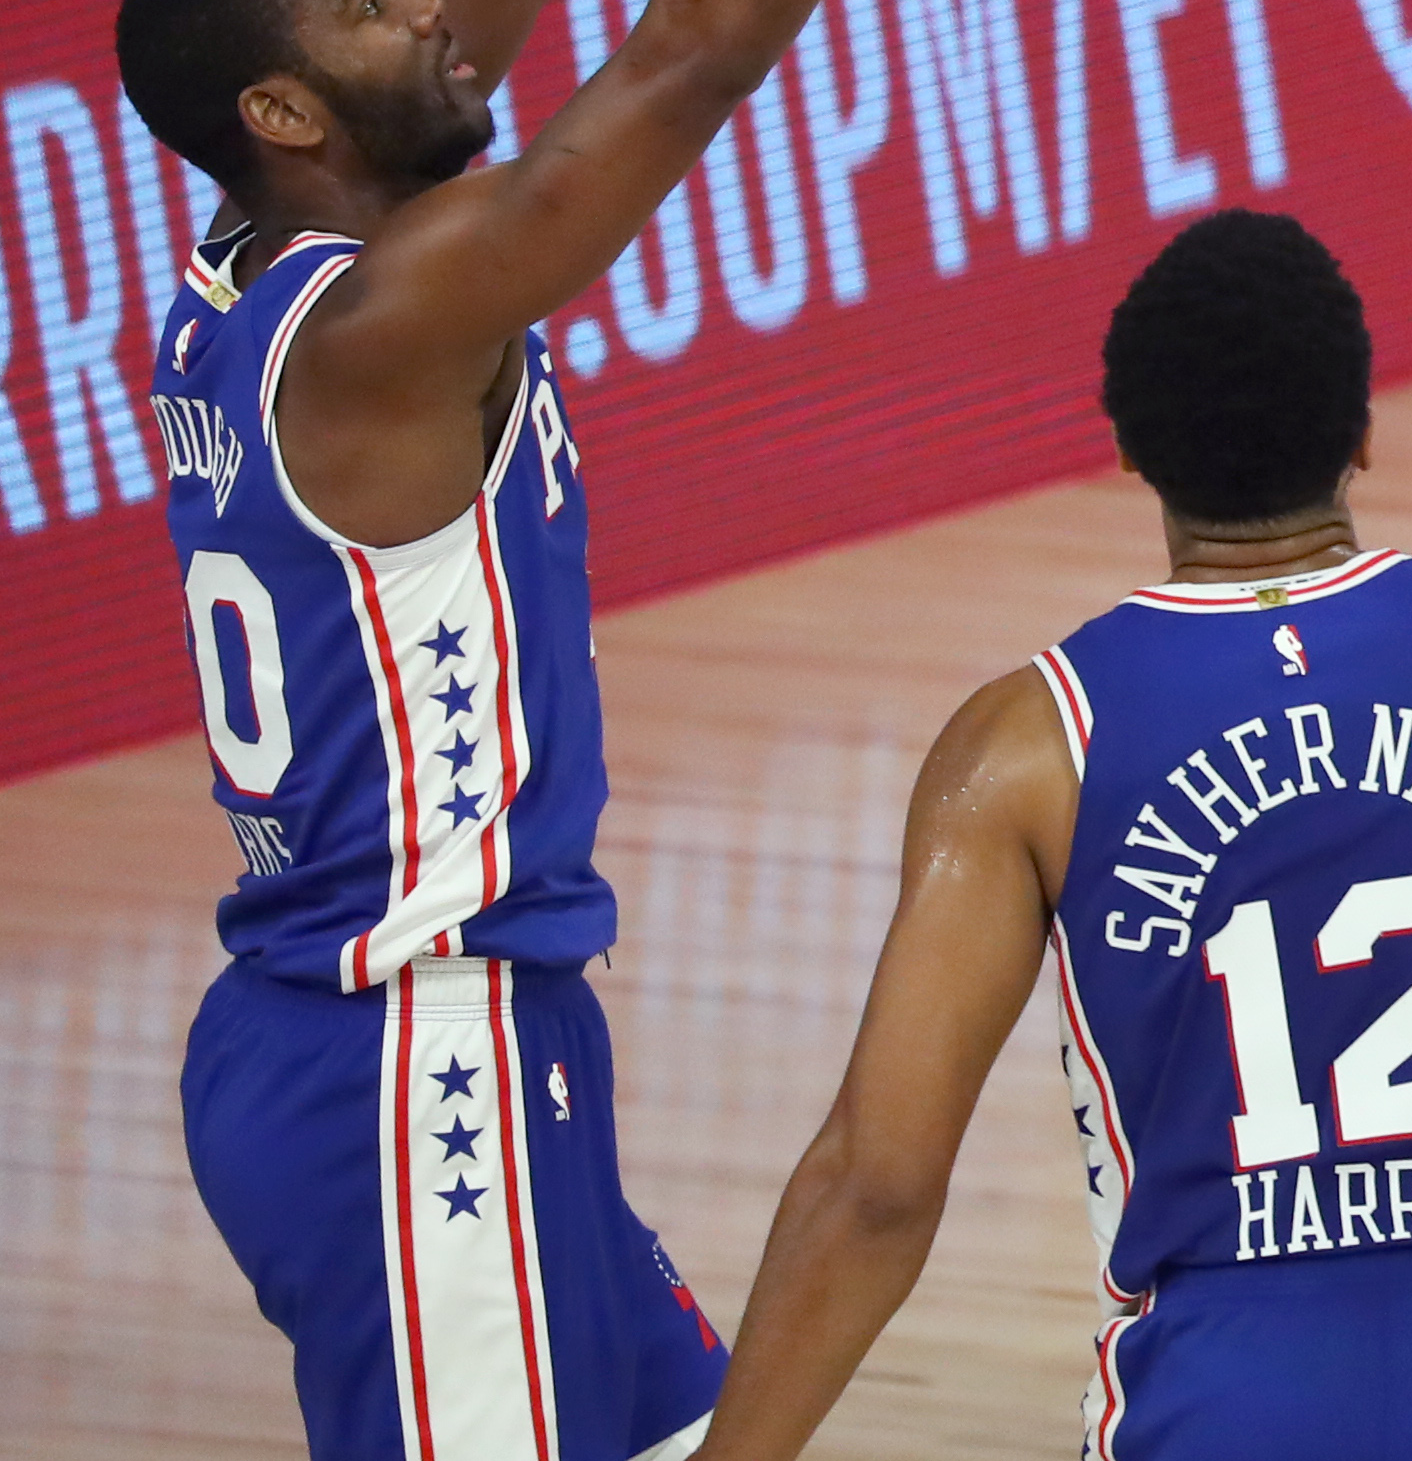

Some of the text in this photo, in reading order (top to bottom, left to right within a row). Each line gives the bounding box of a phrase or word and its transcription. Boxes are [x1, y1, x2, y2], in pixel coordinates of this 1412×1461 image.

[150, 394, 243, 519] OUGH
[184, 550, 294, 799] 0
[1105, 804, 1218, 957] SAY
[1167, 703, 1347, 844] HER
